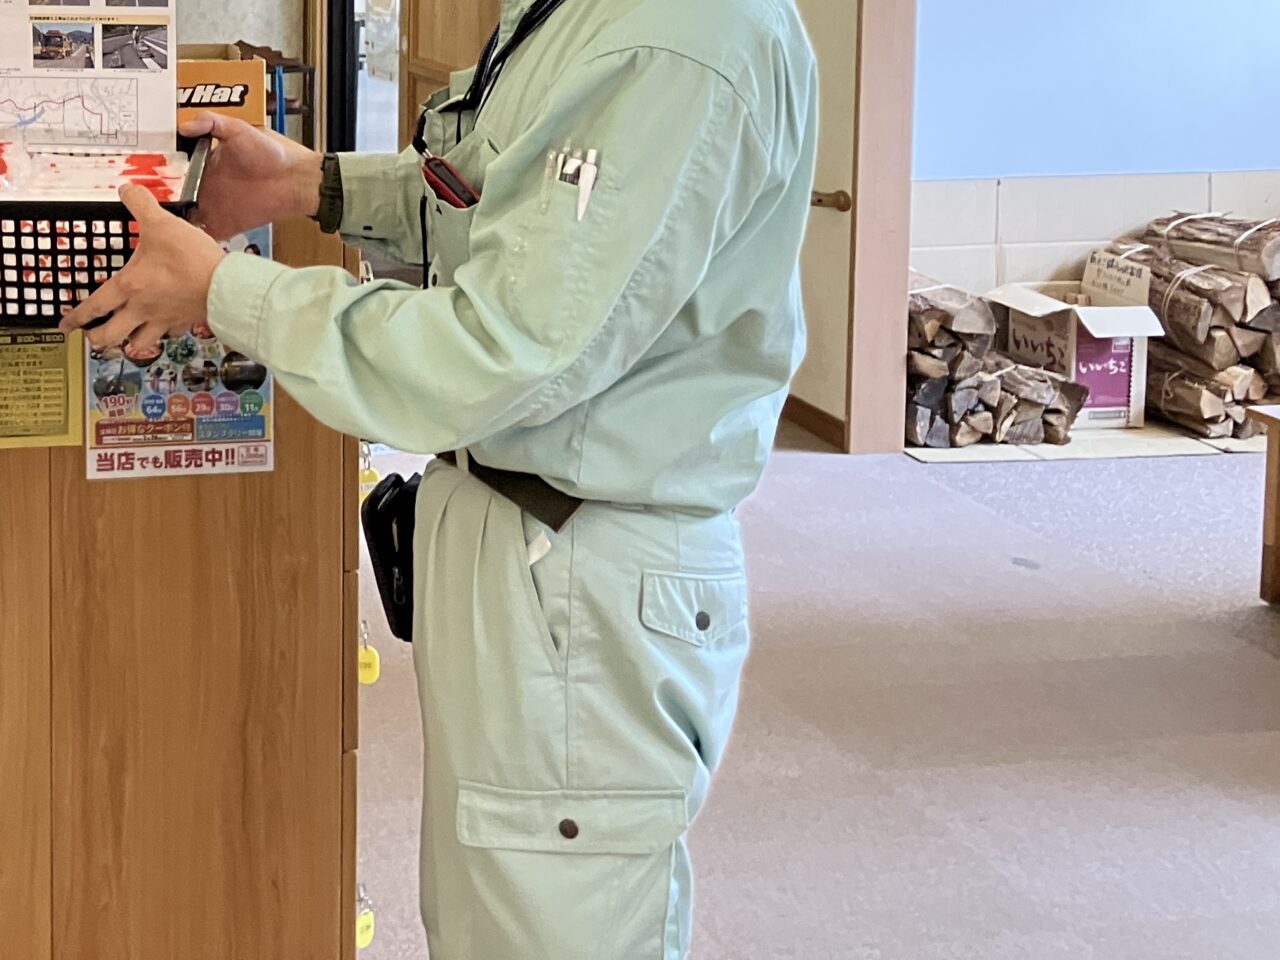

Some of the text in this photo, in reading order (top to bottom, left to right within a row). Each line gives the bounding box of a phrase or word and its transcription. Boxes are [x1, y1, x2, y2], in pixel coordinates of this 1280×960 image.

[96, 448, 235, 472] 当店でも販売中!!
